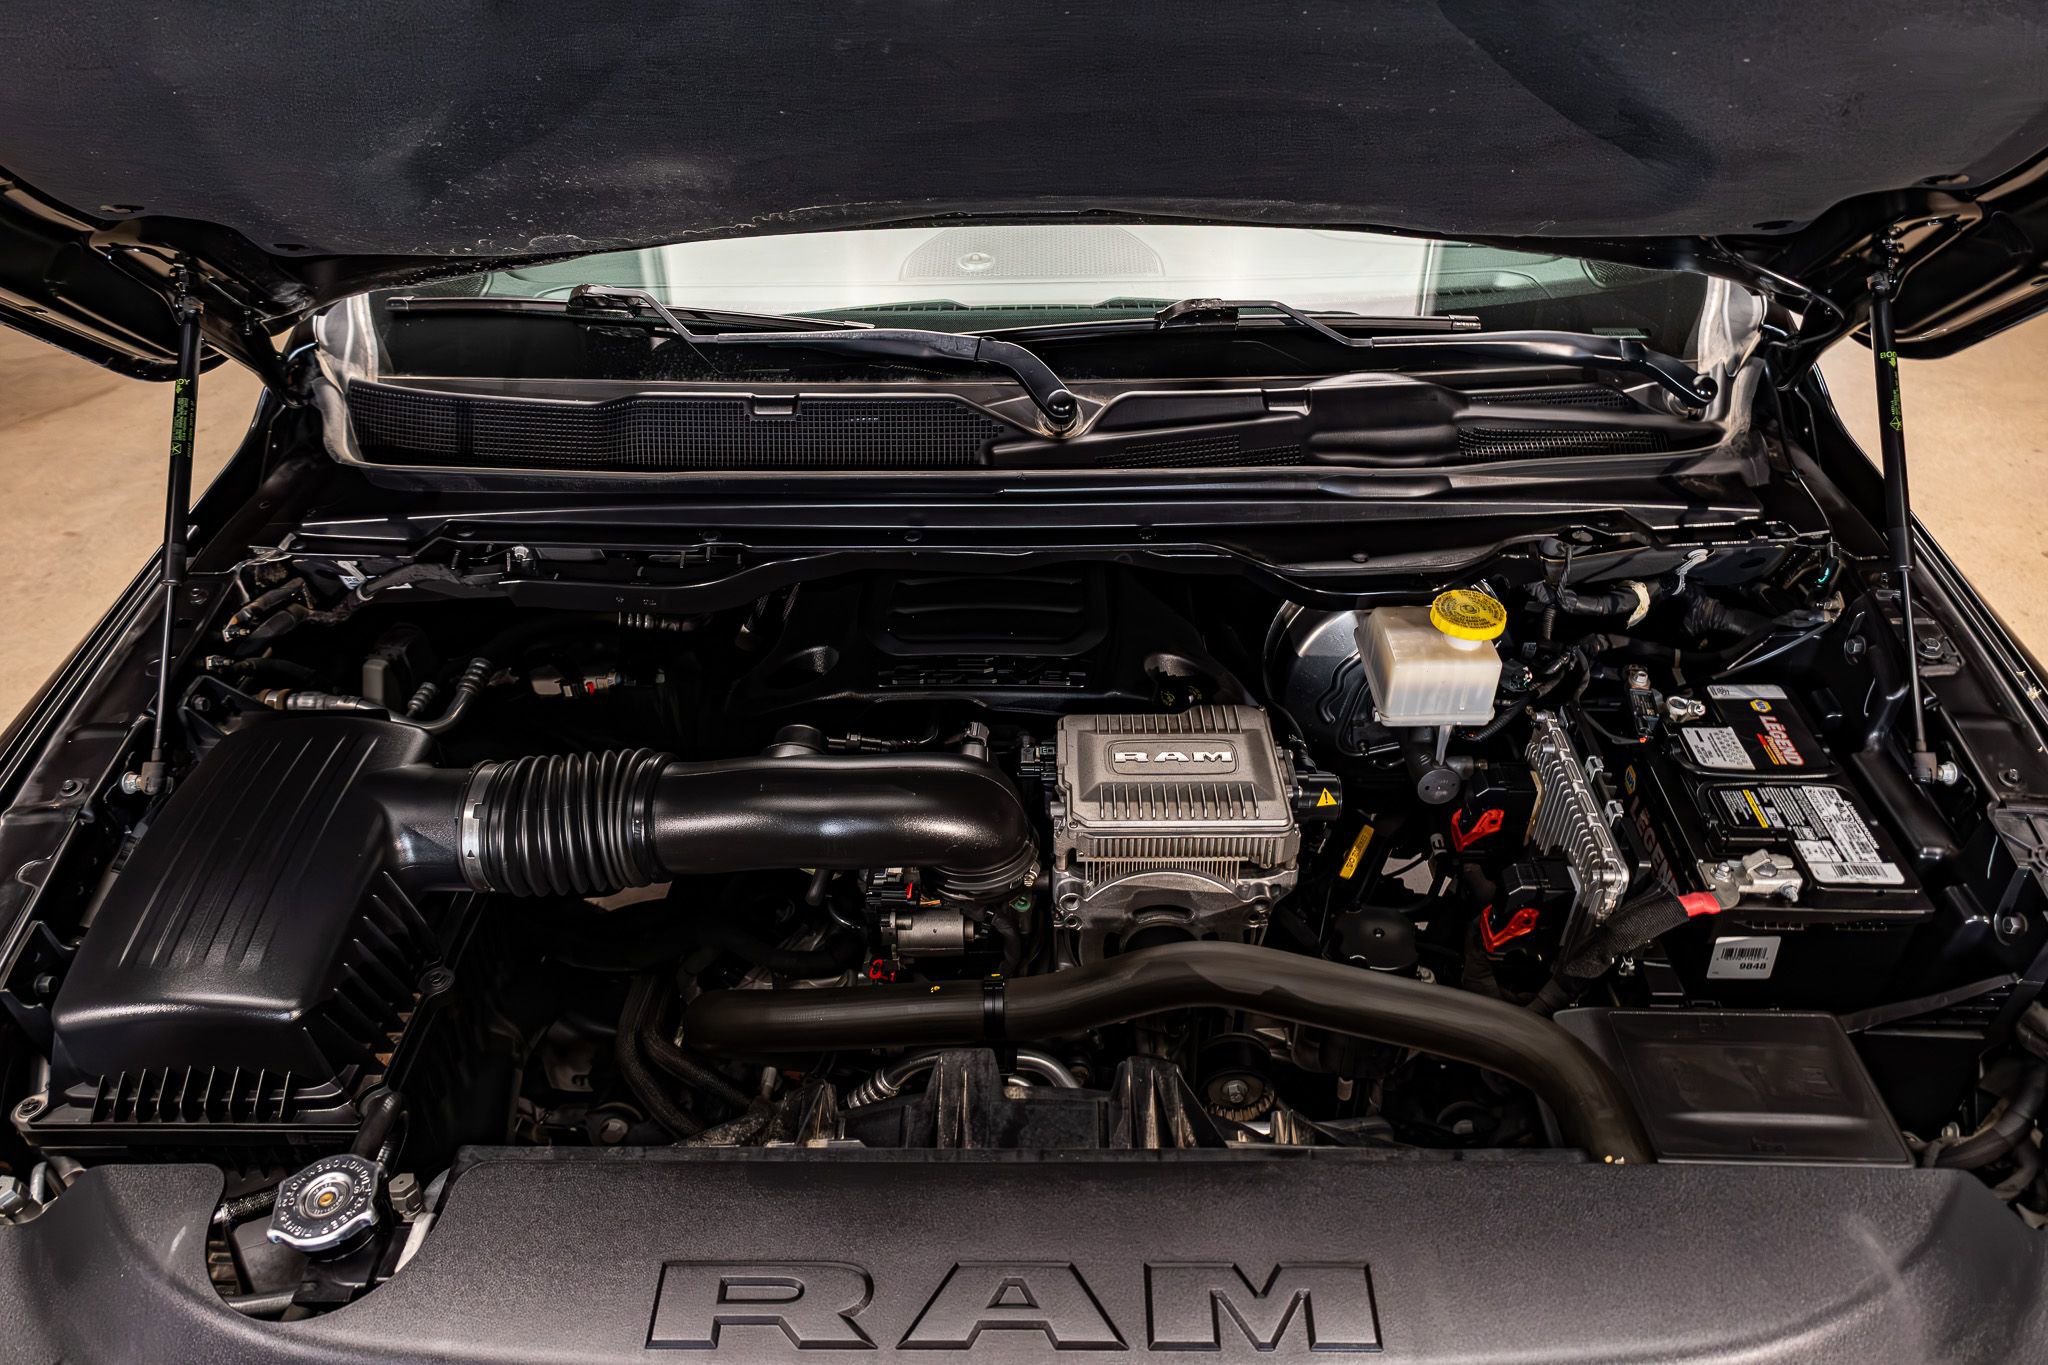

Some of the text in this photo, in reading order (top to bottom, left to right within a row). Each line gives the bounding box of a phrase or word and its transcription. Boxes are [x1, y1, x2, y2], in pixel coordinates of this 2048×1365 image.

[1113, 751, 1234, 763] RAM
[1759, 715, 1805, 766] LEGEND
[645, 1260, 1385, 1351] RAM
